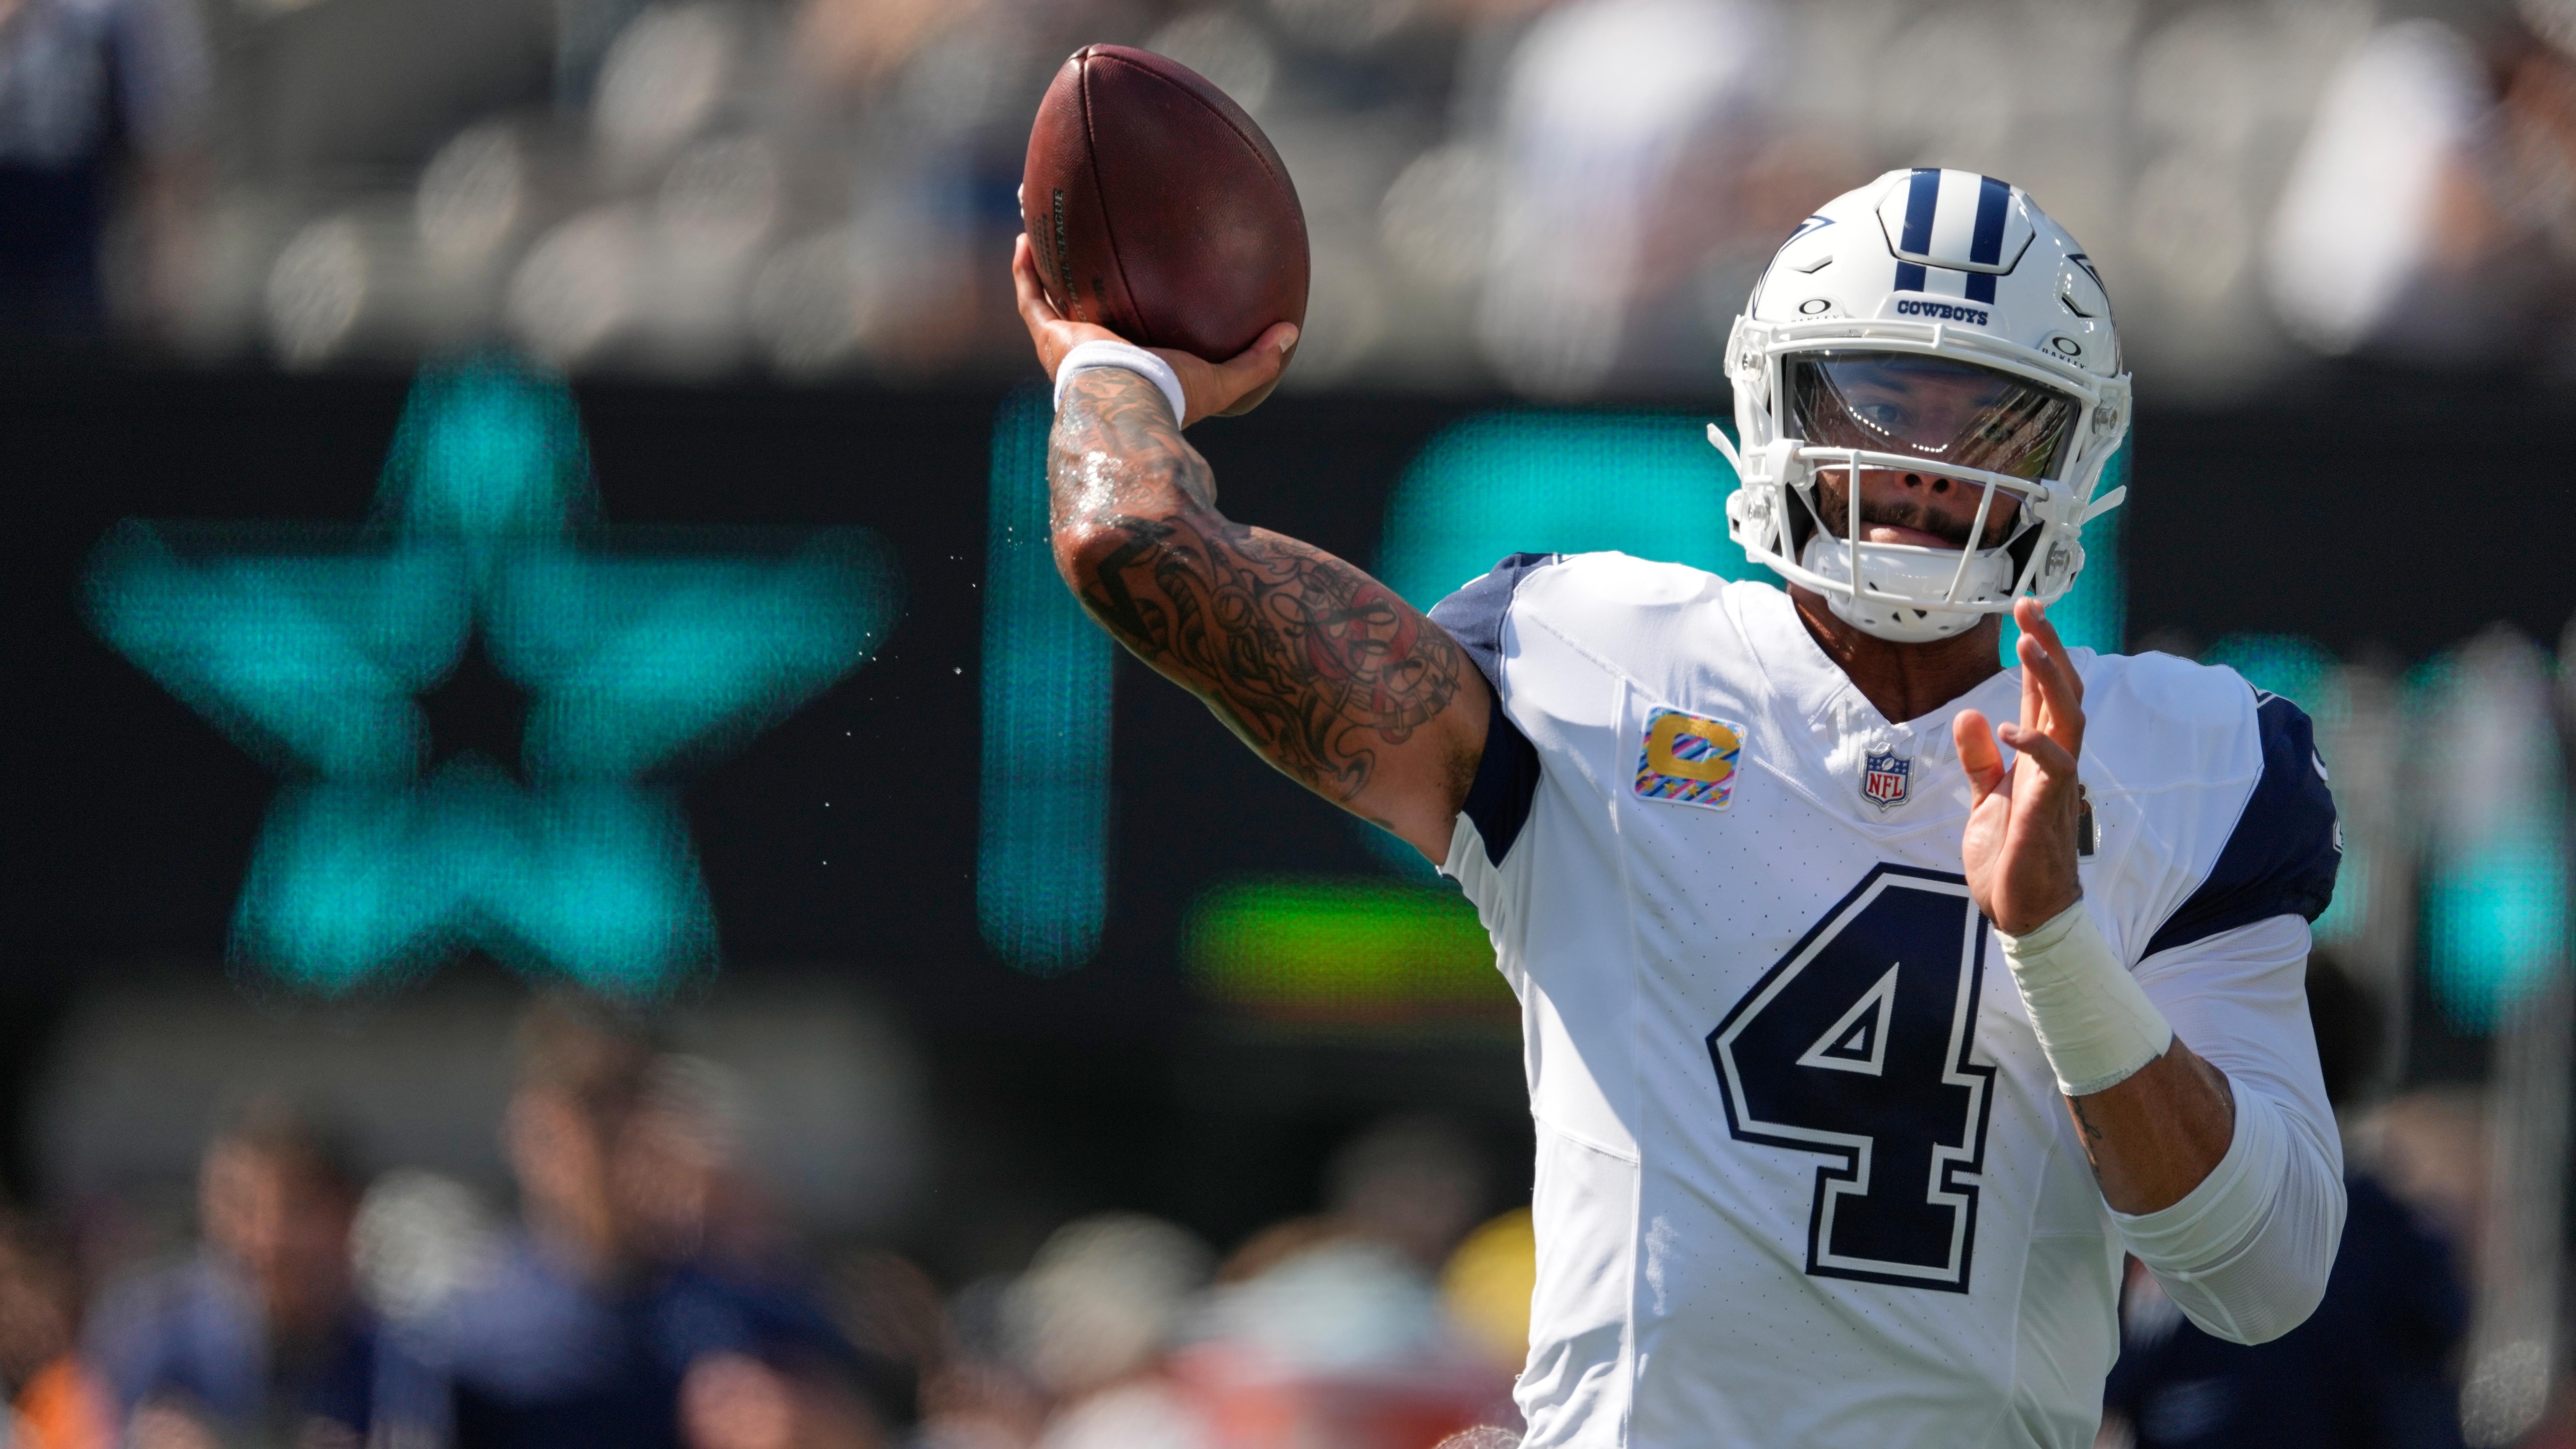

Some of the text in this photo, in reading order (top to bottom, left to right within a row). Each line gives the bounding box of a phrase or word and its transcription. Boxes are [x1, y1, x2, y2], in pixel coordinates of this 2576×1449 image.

[1054, 190, 1066, 256] LEAGUE
[1061, 263, 1087, 323] OTBALL
[1897, 300, 1988, 326] COWBOYS
[1647, 713, 1741, 782] C
[1868, 772, 1903, 799] NFL
[1705, 862, 1997, 1294] 4
